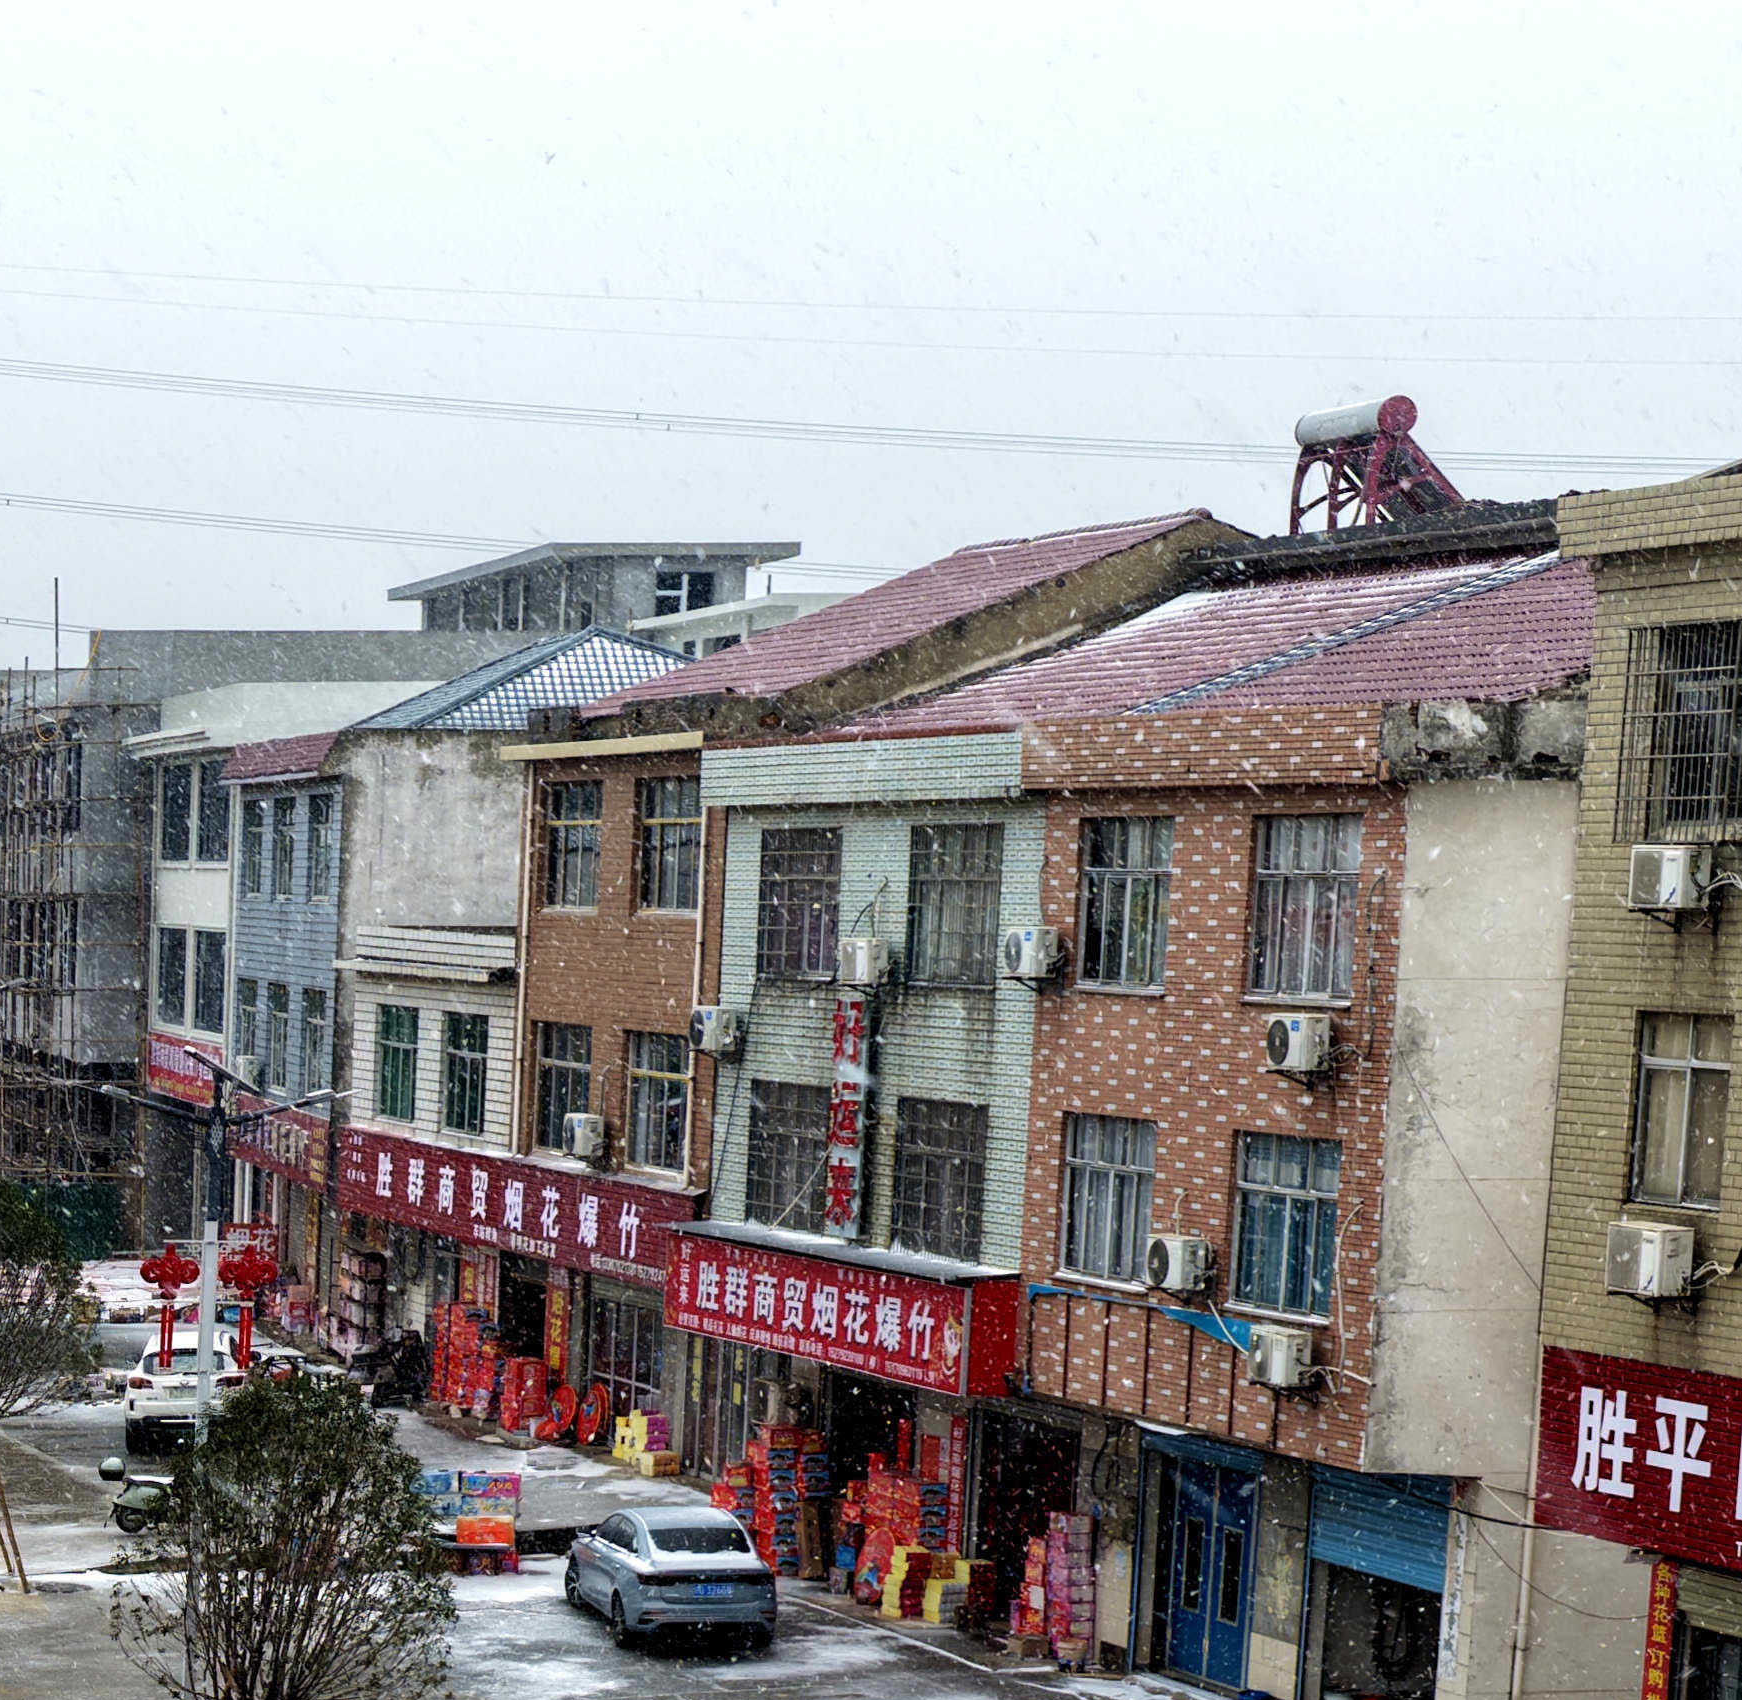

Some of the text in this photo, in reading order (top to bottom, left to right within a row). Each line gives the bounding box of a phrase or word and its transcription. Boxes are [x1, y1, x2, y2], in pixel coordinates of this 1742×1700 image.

[824, 999, 864, 1226] 好运来
[375, 1151, 641, 1260] 胜群商贸烟花爆竹
[678, 1240, 695, 1305] 好运来
[695, 1260, 936, 1362] 胜群商贸烟花爆竹
[1570, 1385, 1742, 1521] 胜平
